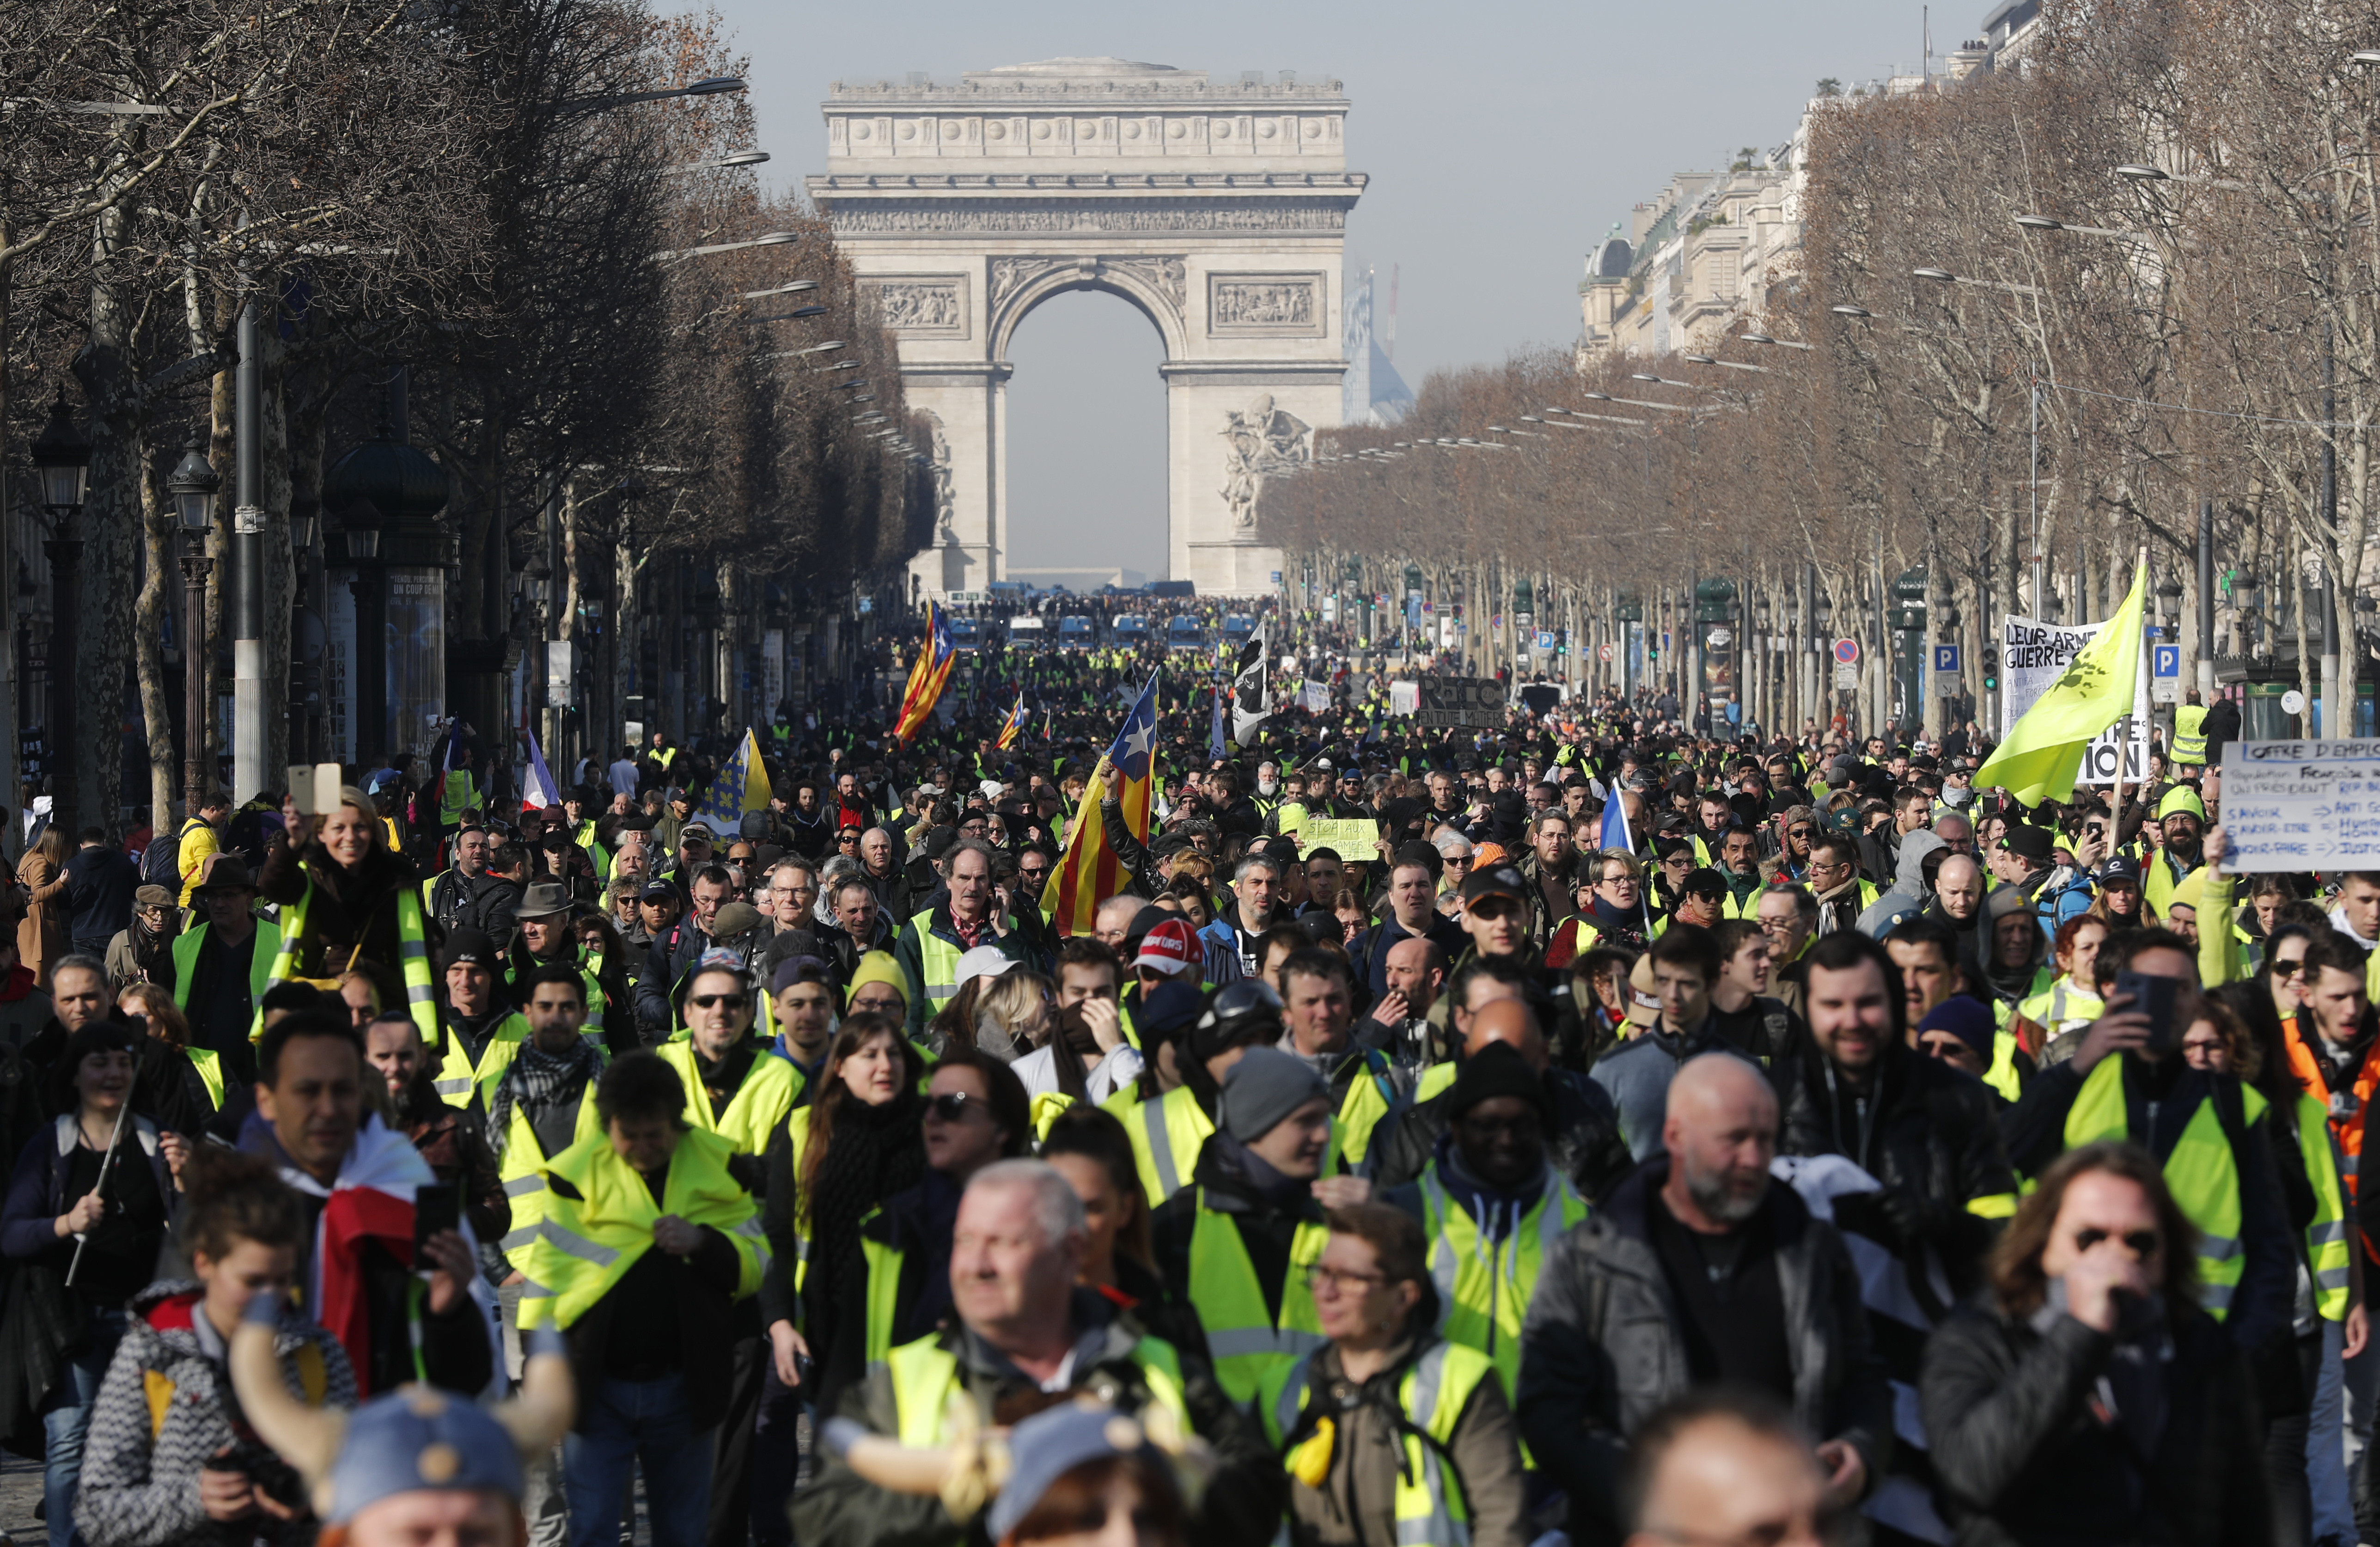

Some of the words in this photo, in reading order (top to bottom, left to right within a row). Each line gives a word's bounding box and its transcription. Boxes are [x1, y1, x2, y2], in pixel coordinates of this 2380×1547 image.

[394, 584, 403, 594] UN
[406, 584, 422, 594] COUP
[1542, 635, 1550, 646] P
[2006, 624, 2047, 645] LEUR
[1941, 649, 1952, 667] P
[2005, 646, 2065, 669] GUERRE
[2160, 650, 2173, 673] P
[2005, 677, 2033, 687] ANTIFA
[1418, 676, 1504, 710] RIC
[1421, 711, 1433, 725] EN
[2251, 744, 2305, 759] OFFRE
[1308, 823, 1338, 833] STOP
[1345, 824, 1366, 833] AUX
